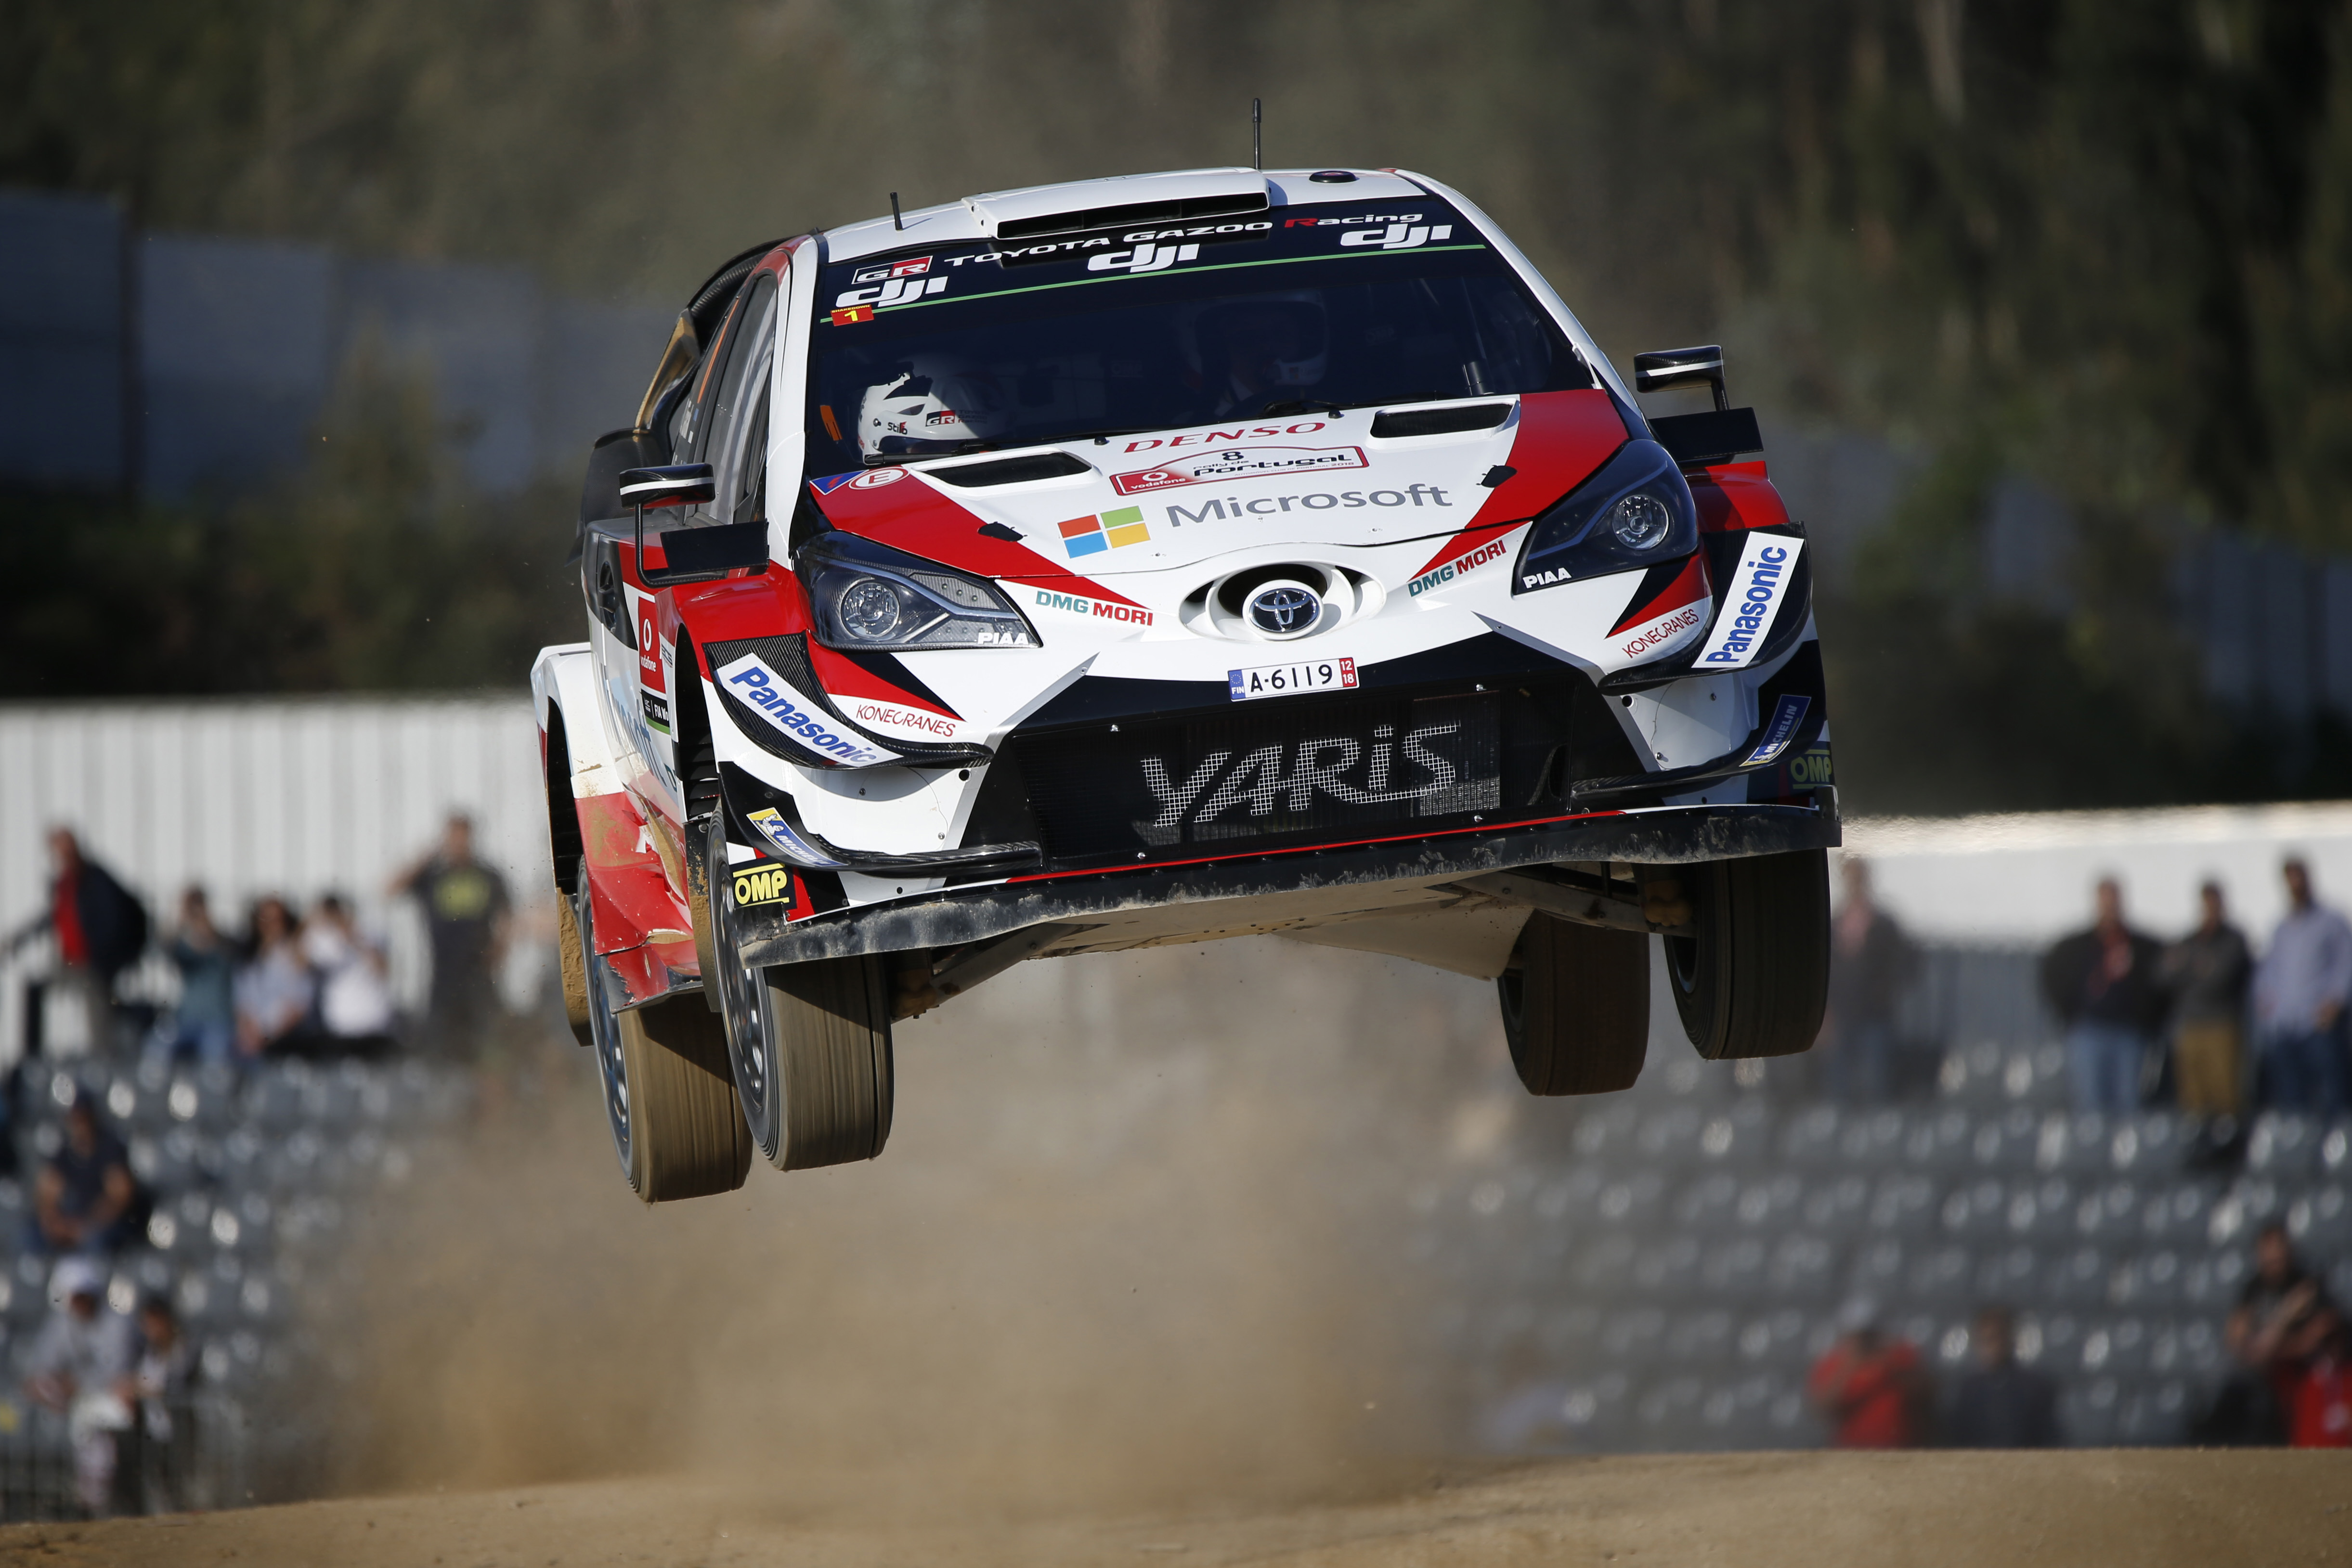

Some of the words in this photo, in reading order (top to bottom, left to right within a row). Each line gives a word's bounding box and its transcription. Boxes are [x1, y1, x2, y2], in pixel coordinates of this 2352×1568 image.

[944, 237, 1110, 266] TOYOTA
[1123, 222, 1273, 242] GAZOO
[1284, 214, 1423, 228] Racing
[857, 263, 926, 282] GR
[832, 305, 870, 313] SHAKEDOWN
[845, 311, 858, 322] 1
[887, 422, 908, 435] Stilo
[926, 415, 955, 426] GR
[1123, 422, 1325, 453] DENSO
[1222, 452, 1244, 461] 8
[868, 472, 891, 484] E
[1131, 478, 1186, 490] vodafone
[1166, 483, 1453, 527] Microsoft
[1408, 565, 1454, 597] DMG
[1456, 540, 1507, 574] MORI
[1523, 567, 1572, 588] PIAA
[1036, 590, 1089, 613] DMG
[1093, 602, 1153, 626] MORI
[1704, 546, 1787, 662] Panasonic
[977, 632, 1028, 645] PIAA
[1622, 609, 1699, 659] KONECRANES
[1250, 664, 1332, 692] A-6119
[1341, 660, 1352, 671] 12
[1343, 673, 1354, 684] 18
[1231, 686, 1245, 694] FIN
[729, 666, 877, 764] Panasonic
[856, 705, 956, 737] KONECRANES
[1764, 704, 1797, 753] MICHELIN
[1791, 756, 1832, 782] OMP
[776, 835, 832, 864] MICHELIN
[735, 870, 787, 904] OMP
